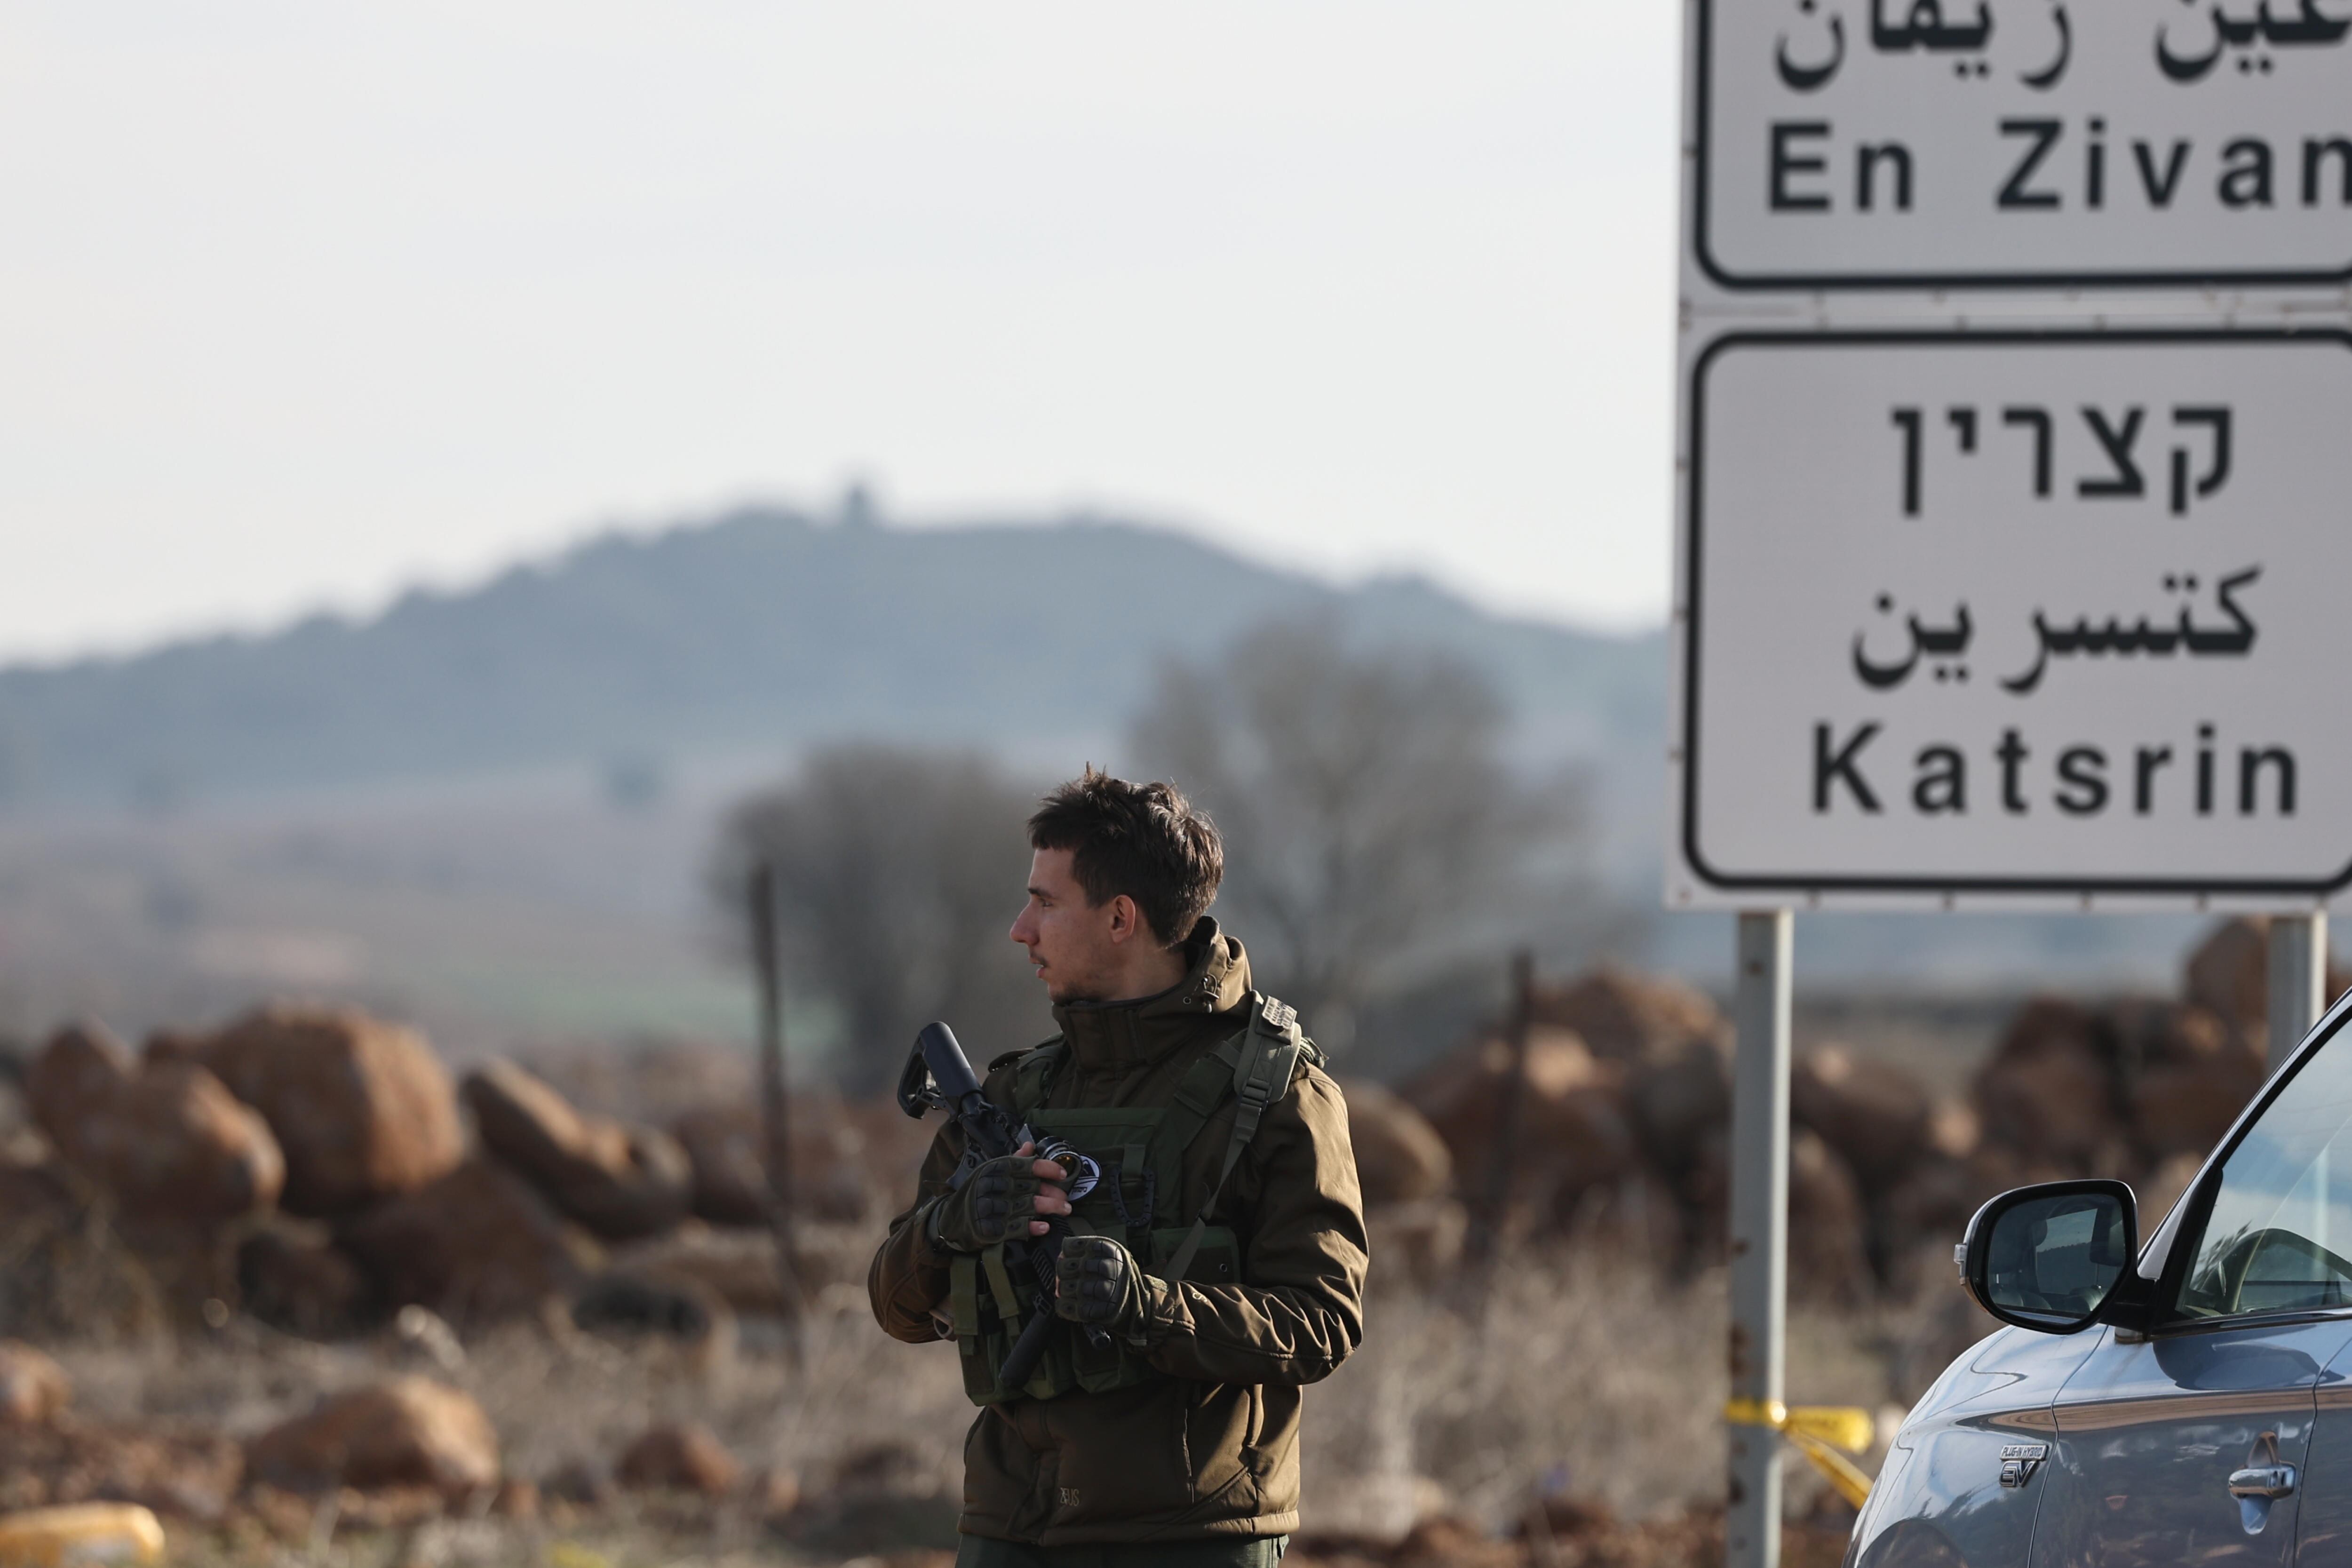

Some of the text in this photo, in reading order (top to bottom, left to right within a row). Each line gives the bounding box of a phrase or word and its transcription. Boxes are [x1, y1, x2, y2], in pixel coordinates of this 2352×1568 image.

[1767, 117, 2352, 213] En Zivan
[1890, 405, 2233, 517] קצרין
[1812, 722, 2297, 817] Katsrin
[1999, 1460, 2037, 1487] EV
[2002, 1447, 2043, 1457] PLUG-IN HYBRID
